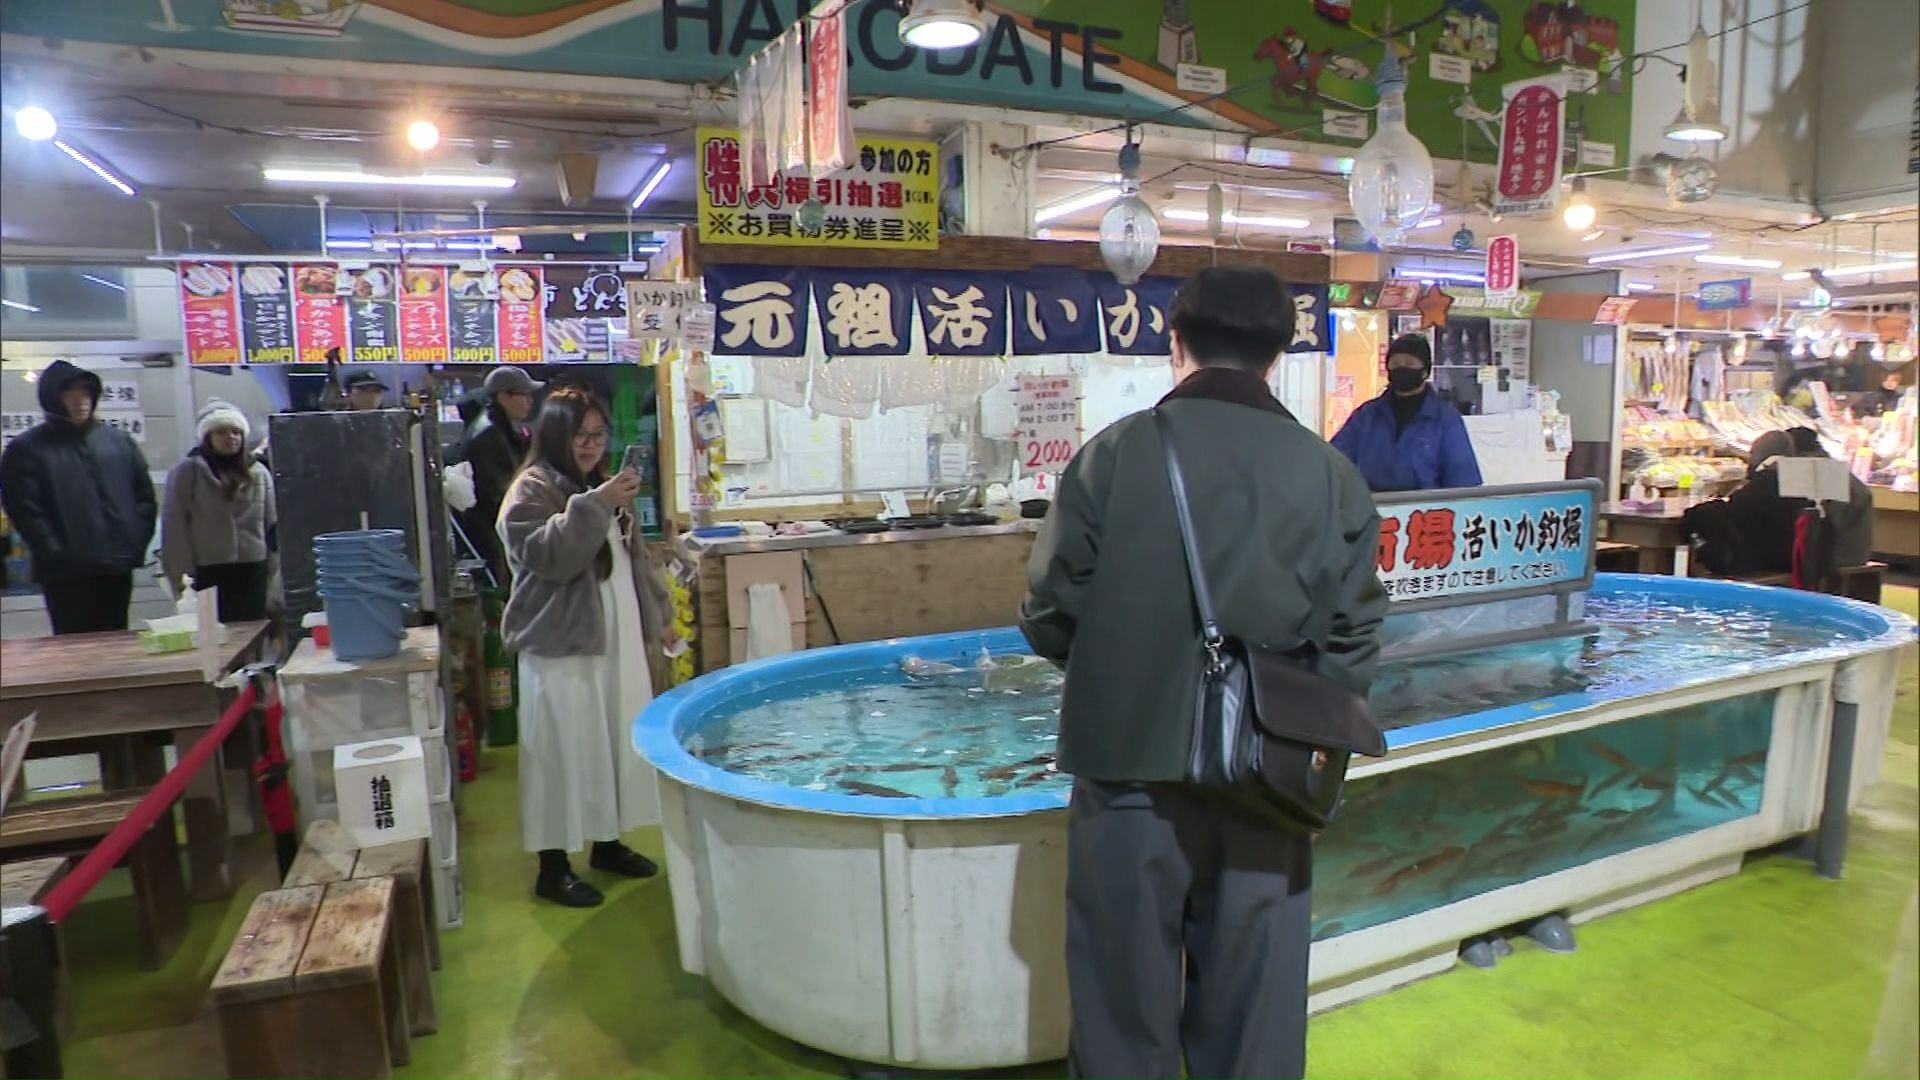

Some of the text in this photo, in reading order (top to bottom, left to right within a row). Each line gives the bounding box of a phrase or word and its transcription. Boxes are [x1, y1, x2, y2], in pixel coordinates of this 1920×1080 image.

[720, 281, 1318, 348] 元祖活いか堀
[354, 347, 397, 361] 550円
[405, 347, 446, 361] 500円
[453, 347, 495, 361] 500円
[502, 347, 543, 361] 500円
[1462, 507, 1582, 561] 活いか釣堀
